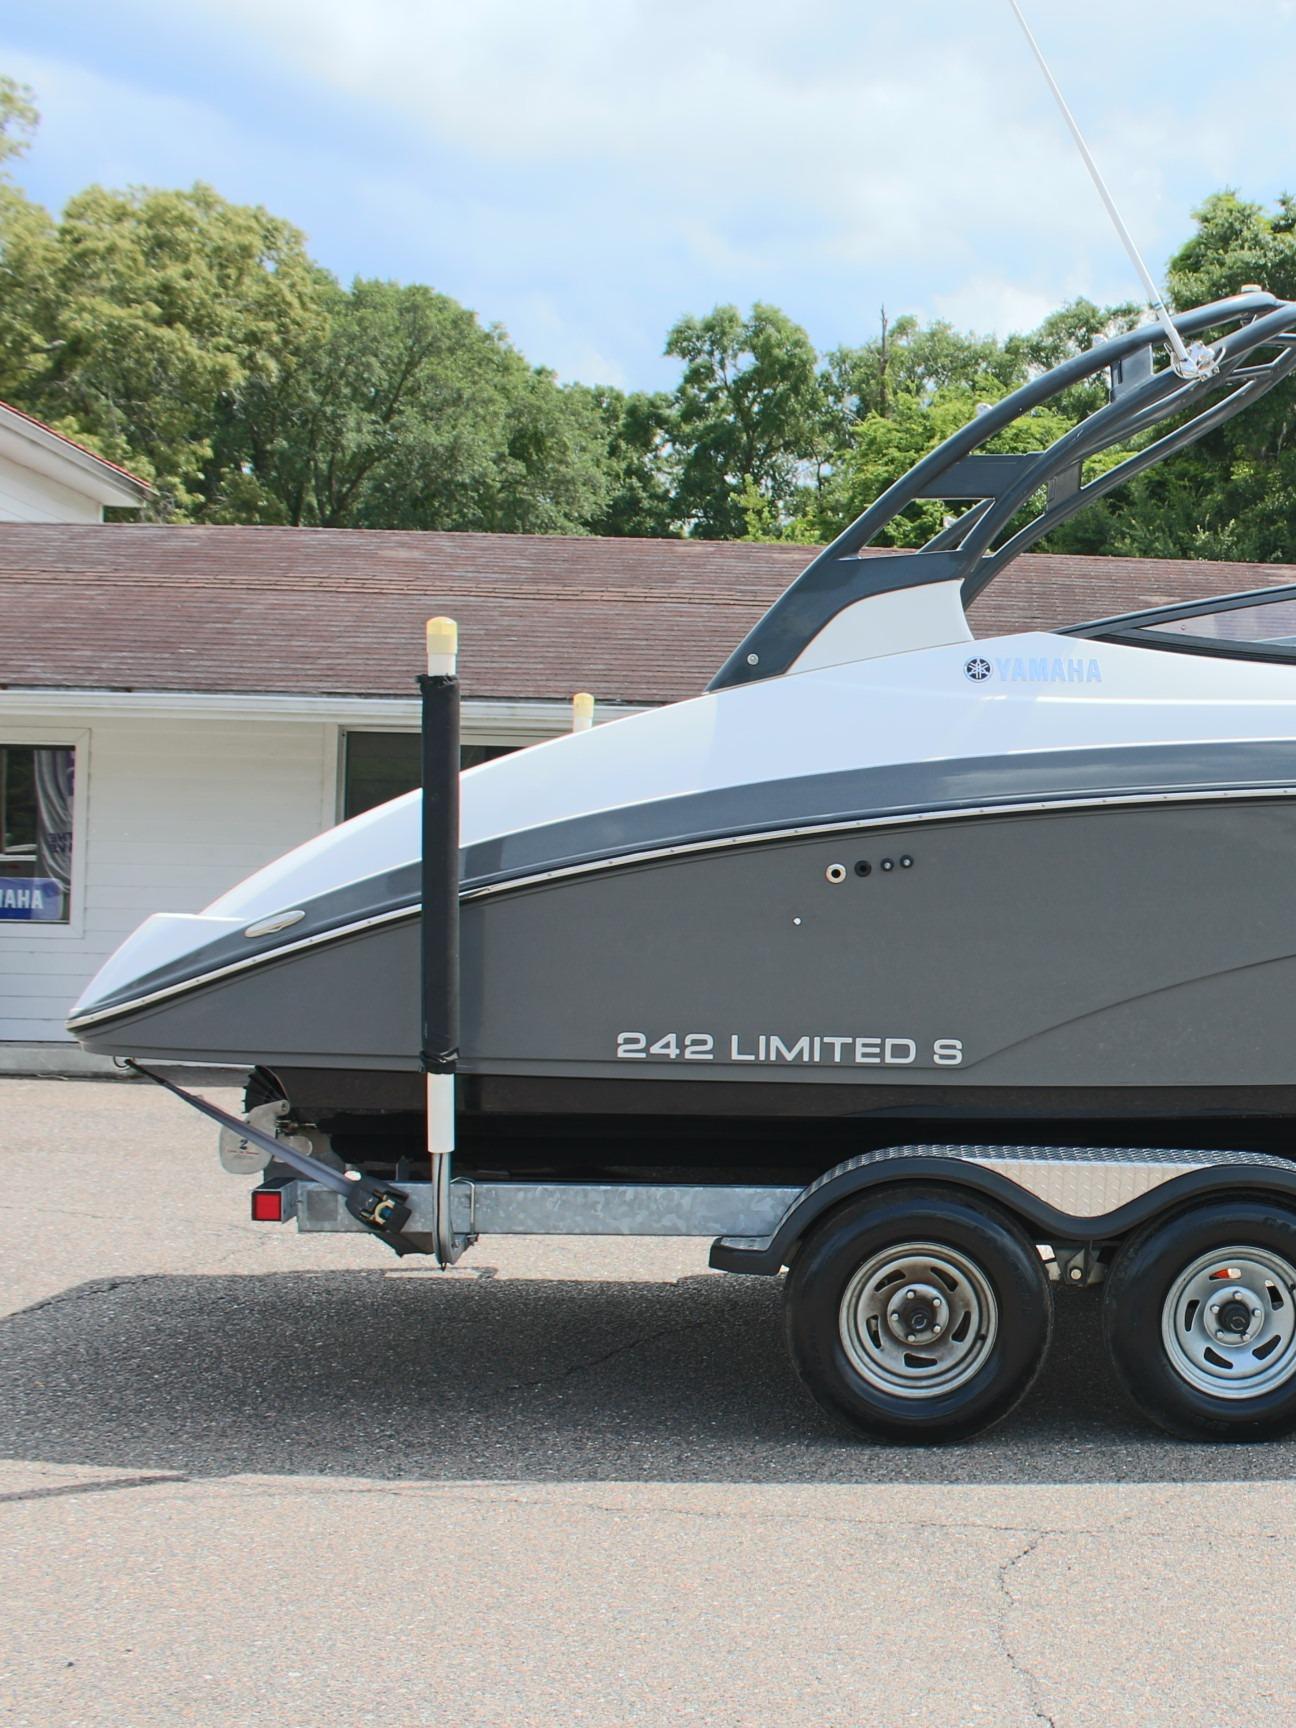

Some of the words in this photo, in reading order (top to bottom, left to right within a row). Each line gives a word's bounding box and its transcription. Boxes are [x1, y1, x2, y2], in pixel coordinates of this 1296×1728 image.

[996, 657, 1102, 682] YAMAHA
[616, 1031, 715, 1060] 242
[730, 1033, 917, 1065] LIMITED
[932, 1038, 963, 1066] S
